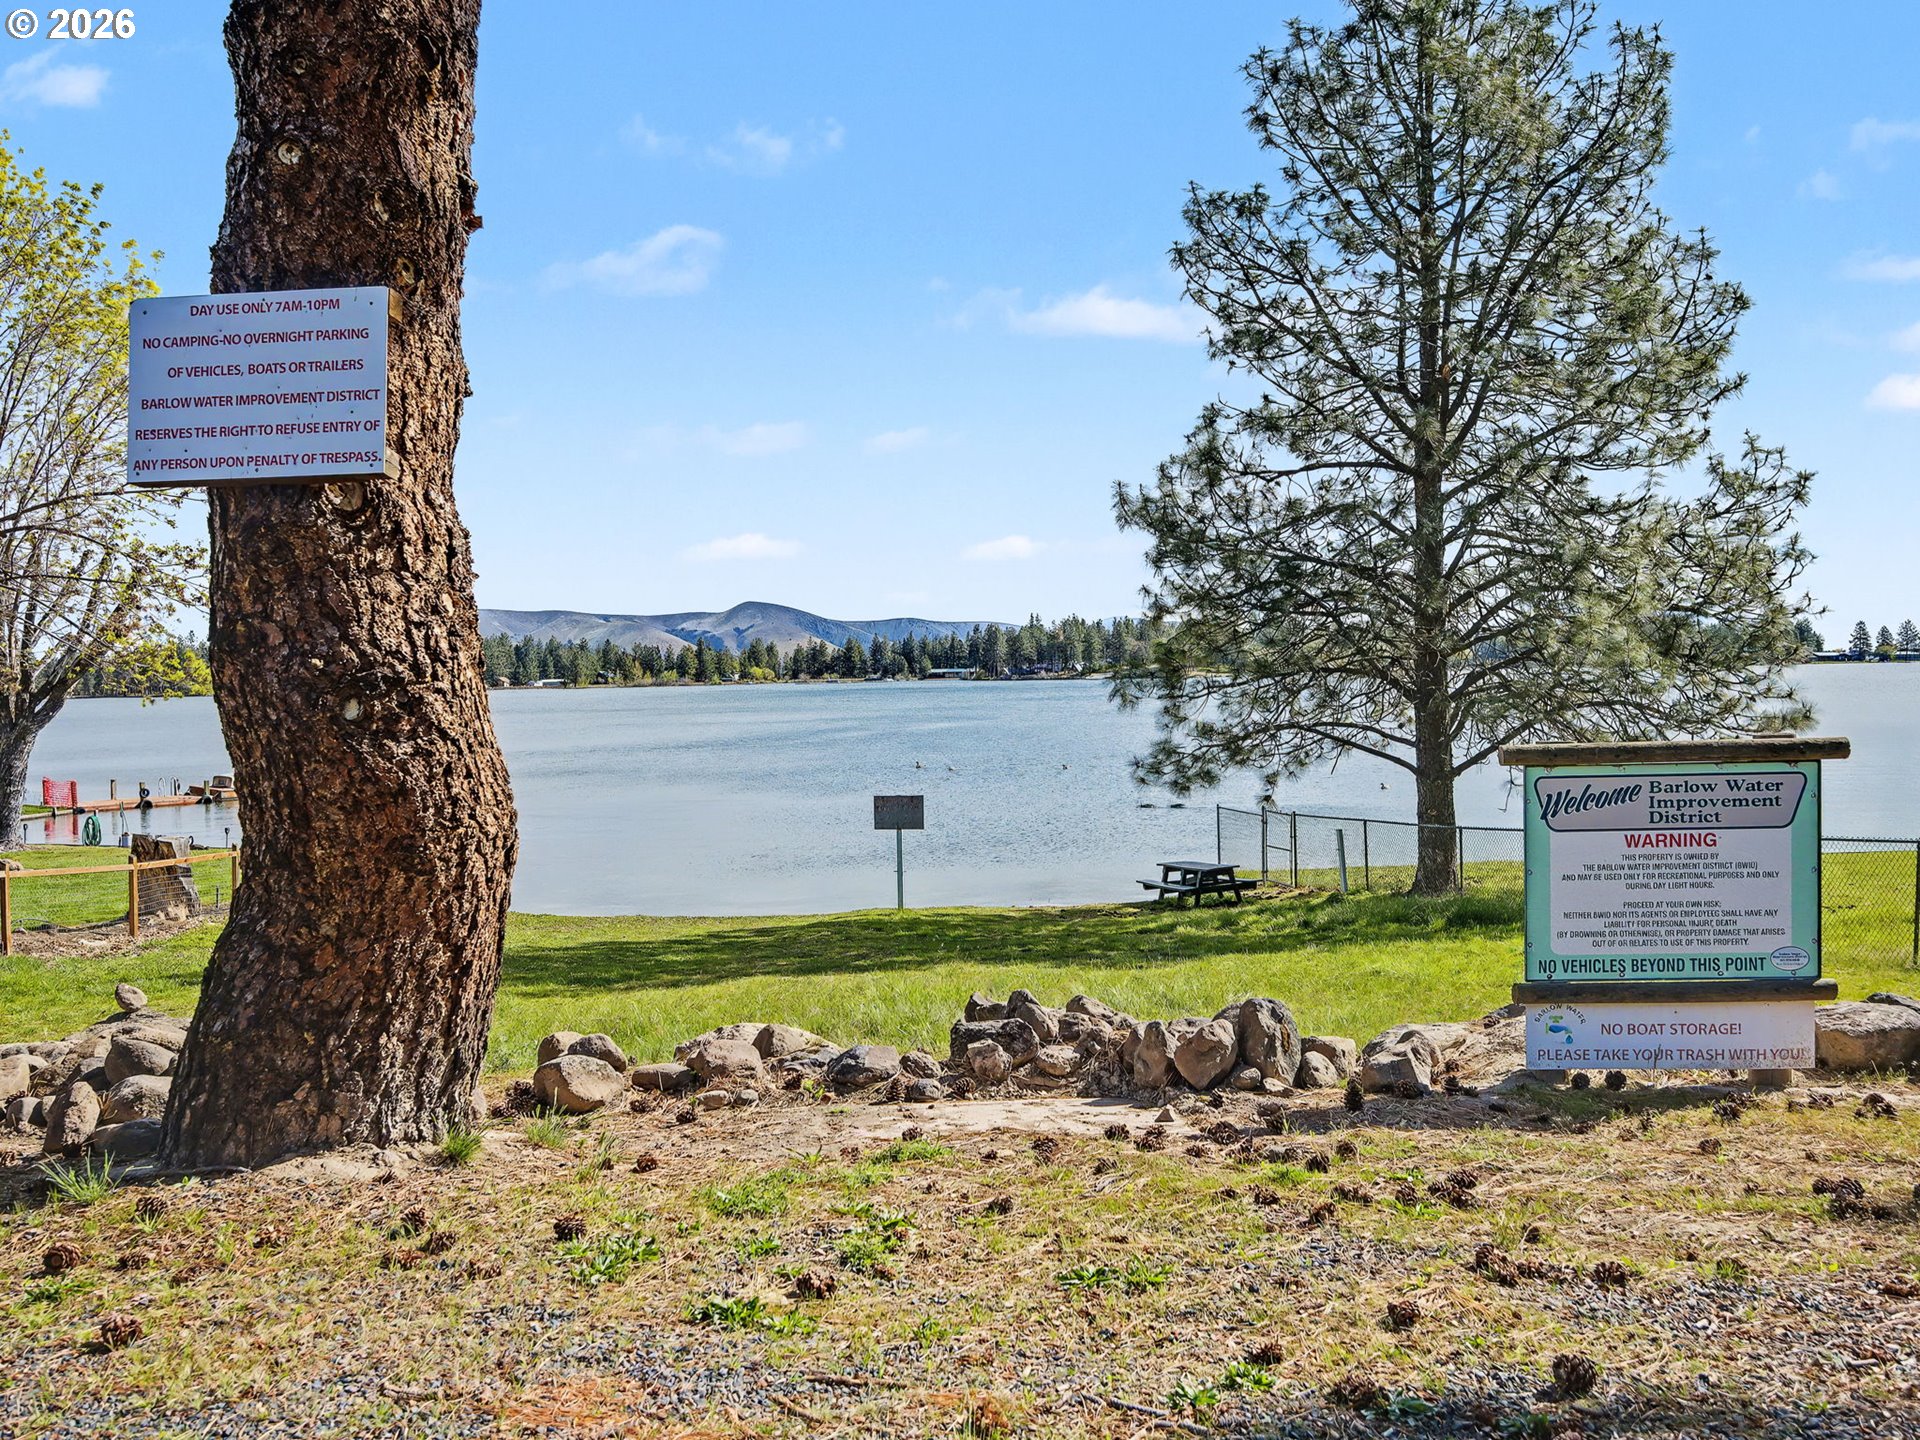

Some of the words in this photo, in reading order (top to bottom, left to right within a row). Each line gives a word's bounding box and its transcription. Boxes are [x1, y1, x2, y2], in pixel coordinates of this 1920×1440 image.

[190, 305, 214, 317] DAY
[217, 303, 239, 315] USE
[242, 302, 273, 314] ONLY
[275, 299, 340, 312] 7AM-10PM
[142, 338, 161, 349] NO
[163, 334, 242, 348] CAMPING-NO
[244, 331, 313, 344] OVERNIGHT
[316, 328, 369, 341] PARKING
[168, 367, 183, 378] OF
[186, 365, 244, 377] VEHICLES,
[248, 363, 286, 374] BOATS
[288, 362, 305, 372] OR
[307, 359, 363, 371] TRAILERS
[141, 398, 193, 410] BARLOW
[194, 396, 233, 408] WATER
[236, 392, 325, 406] IMPROVEMENT
[326, 389, 380, 402] DISTRICT
[135, 428, 193, 441] RESERVES
[195, 427, 217, 438] THE
[220, 426, 255, 437] RIGHT
[257, 425, 273, 436] TO
[276, 423, 320, 435] REFUSE
[323, 421, 361, 433] ENTRY
[363, 420, 380, 431] OF
[133, 460, 158, 471] ANY
[160, 458, 207, 470] PERSON
[210, 456, 244, 468] UPON
[247, 454, 298, 466] PENALTY
[302, 453, 318, 464] OF
[319, 451, 381, 464] TRESPASS.
[1649, 781, 1718, 794] Barlow
[1725, 779, 1783, 792] Water
[1540, 784, 1642, 821] Welcome
[1649, 795, 1782, 811] Improvement
[1649, 811, 1722, 824] District
[1624, 833, 1718, 848] WARNING
[1764, 909, 1778, 917] ANY
[1557, 931, 1568, 939] (BY
[1629, 939, 1658, 947] RELATES
[1538, 960, 1557, 974] NO
[1563, 959, 1626, 974] VEHICLES
[1632, 958, 1685, 972] BEYOND
[1689, 958, 1720, 971] THIS
[1725, 957, 1766, 971] POINT
[1534, 1002, 1562, 1022] BARLOW
[1566, 1005, 1586, 1024] WATER
[1601, 1023, 1623, 1035] NO
[1627, 1023, 1666, 1035] BOAT
[1669, 1023, 1741, 1035] STORAGE!
[1537, 1049, 1590, 1061] PLEASE
[1593, 1049, 1629, 1060] TAKE
[1633, 1049, 1673, 1061] YOUR
[1677, 1049, 1725, 1060] TRASH
[1728, 1049, 1767, 1060] WITH
[1769, 1048, 1804, 1060] YOU!
